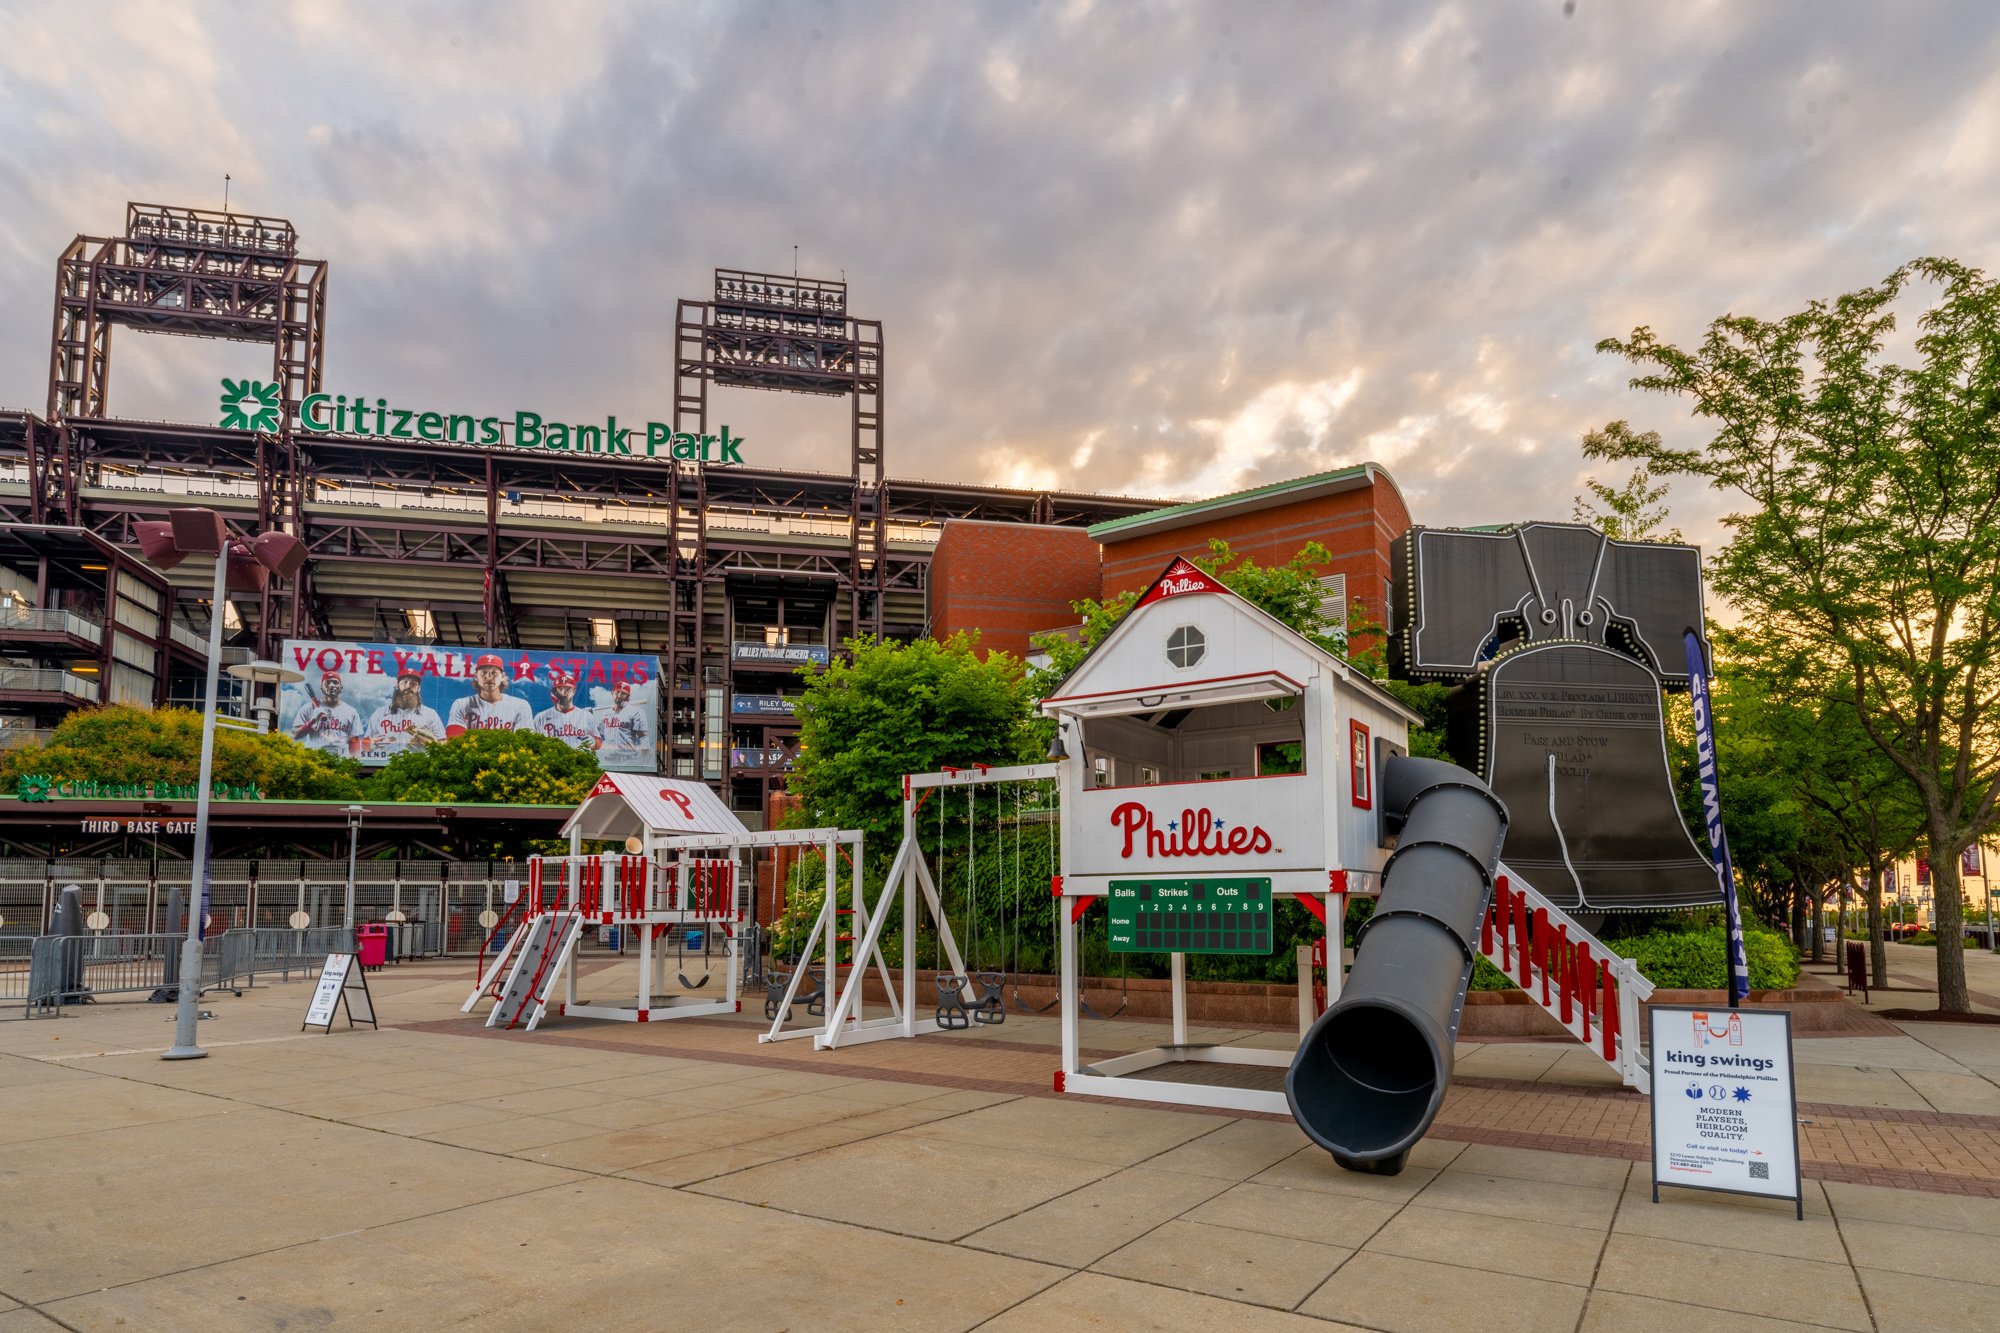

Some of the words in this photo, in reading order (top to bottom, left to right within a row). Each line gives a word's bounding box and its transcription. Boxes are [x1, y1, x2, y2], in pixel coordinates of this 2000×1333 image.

[300, 393, 500, 445] Citizens
[515, 411, 632, 456] Bank
[646, 421, 745, 465] Park
[1160, 578, 1205, 596] Phillies
[293, 647, 384, 674] VOTE
[548, 657, 649, 685] STARS
[1607, 691, 1653, 704] LIBERTY
[56, 779, 148, 799] Citizens
[213, 782, 263, 801] Park
[659, 788, 695, 821] P
[80, 819, 119, 834] THIRD
[126, 821, 160, 834] BASE
[166, 821, 198, 834] GATE
[1110, 801, 1273, 860] Phillies
[1114, 888, 1136, 897] Balls
[1158, 887, 1189, 897] Strikes
[1216, 887, 1239, 897] Outs
[1211, 903, 1217, 911] 6
[1227, 903, 1233, 911] 7
[1242, 903, 1249, 911] 8
[1257, 902, 1264, 911] 9
[1111, 917, 1130, 925] Home
[1112, 935, 1130, 943] Away
[1666, 1050, 1706, 1068] king
[1710, 1053, 1774, 1072] swings
[1719, 1073, 1756, 1081] Philadelphia
[1700, 1107, 1742, 1117] MODERN
[1696, 1114, 1748, 1126] PLAYSETS,
[1696, 1122, 1748, 1133] HEIRLOOM
[1700, 1130, 1745, 1141] QUALITY.
[1729, 1147, 1748, 1155] today!
